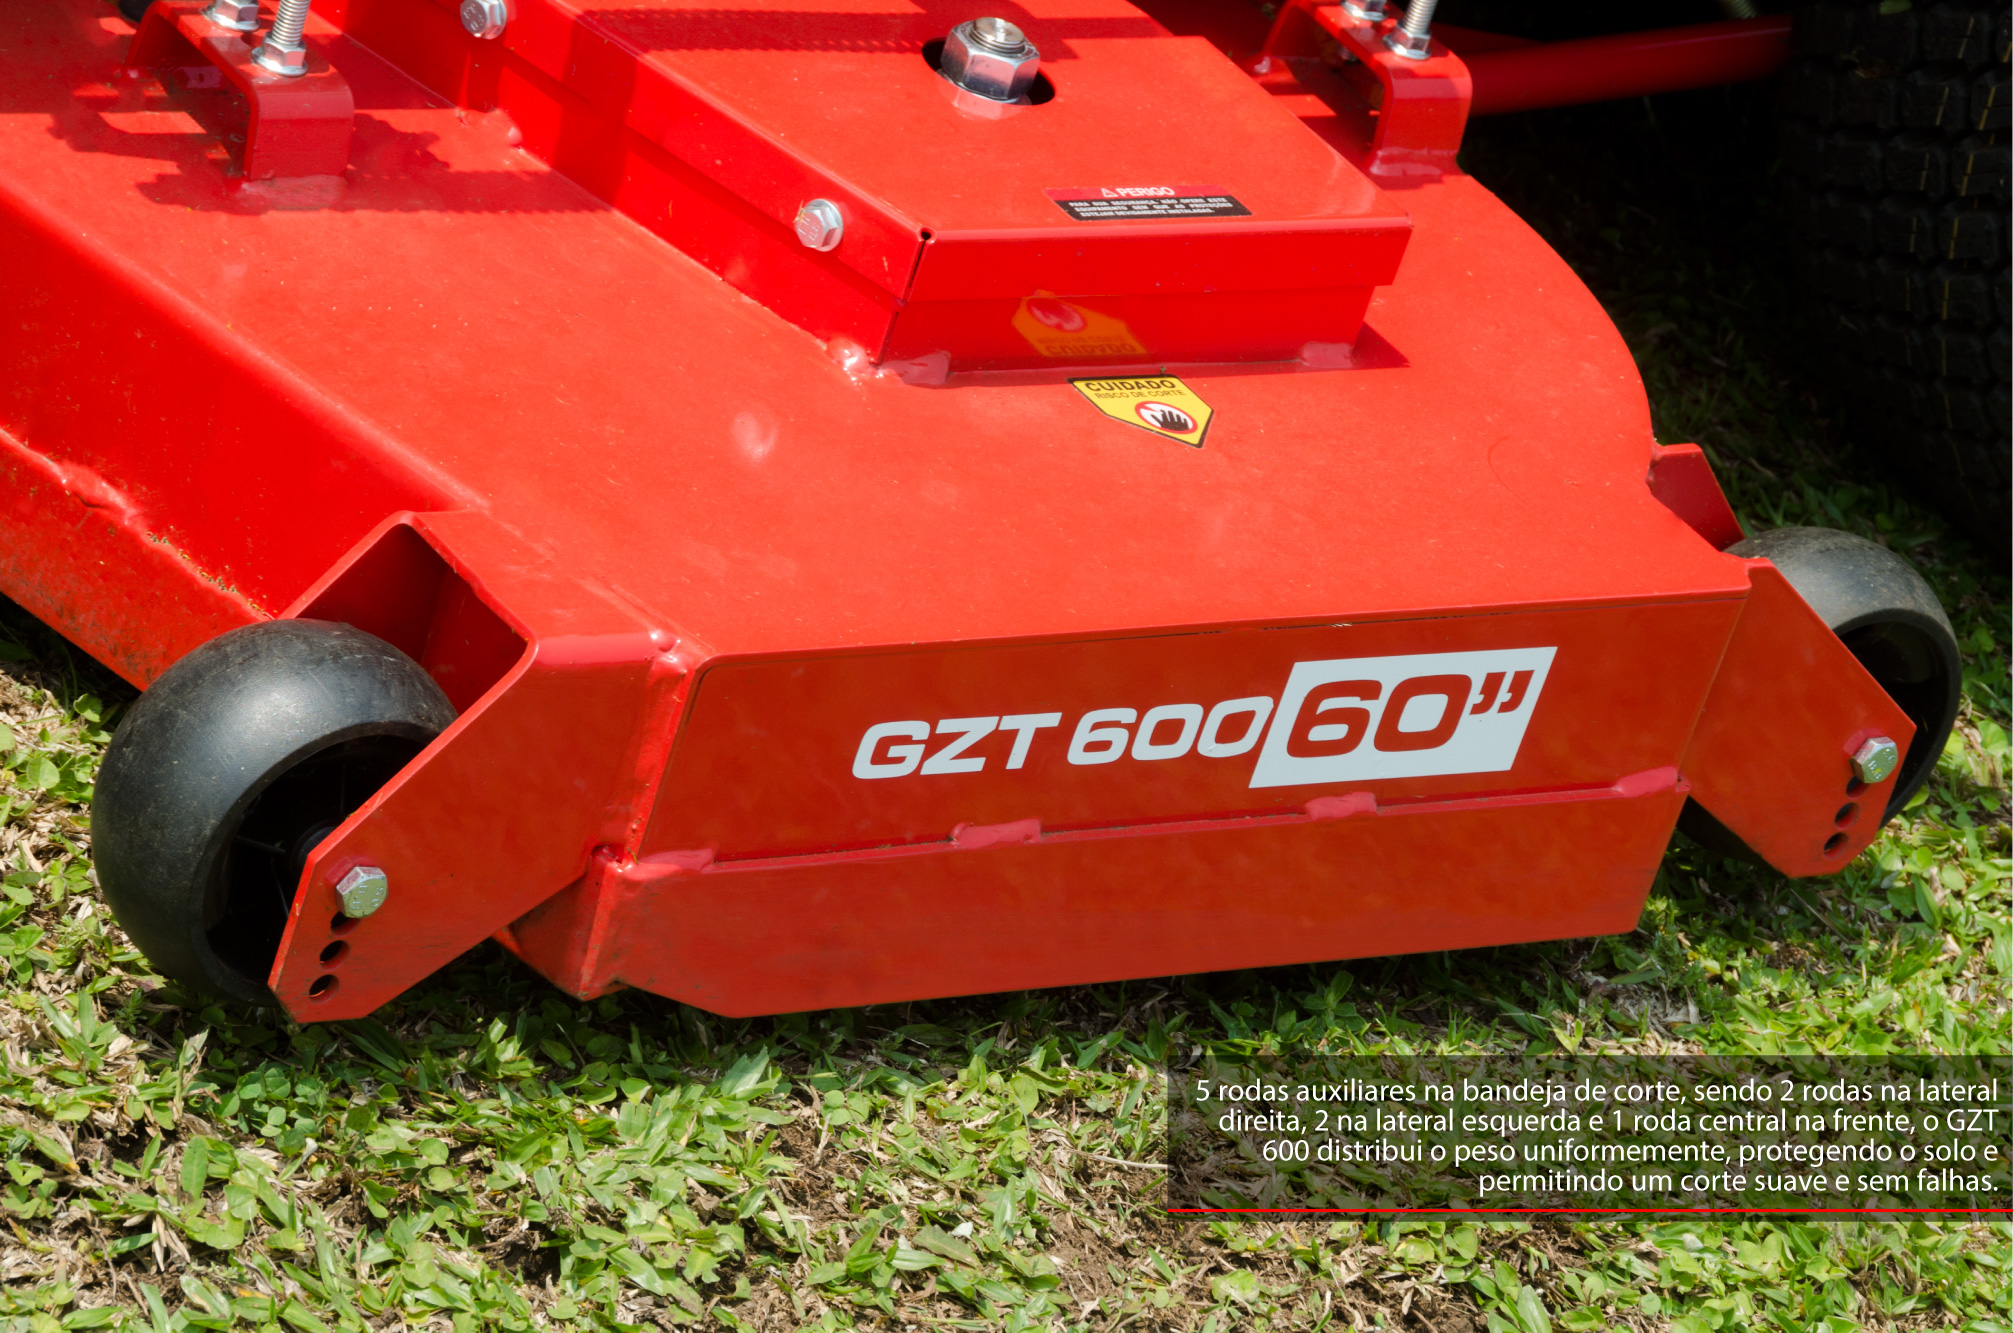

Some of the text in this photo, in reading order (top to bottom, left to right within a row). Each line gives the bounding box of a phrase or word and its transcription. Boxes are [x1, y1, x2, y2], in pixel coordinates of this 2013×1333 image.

[1115, 186, 1175, 197] PERIGO
[1084, 379, 1176, 392] CUIDADO
[1094, 391, 1129, 400] RISCO
[1147, 389, 1186, 397] CORTE
[852, 712, 1062, 780] GZT
[1066, 695, 1275, 765] 600
